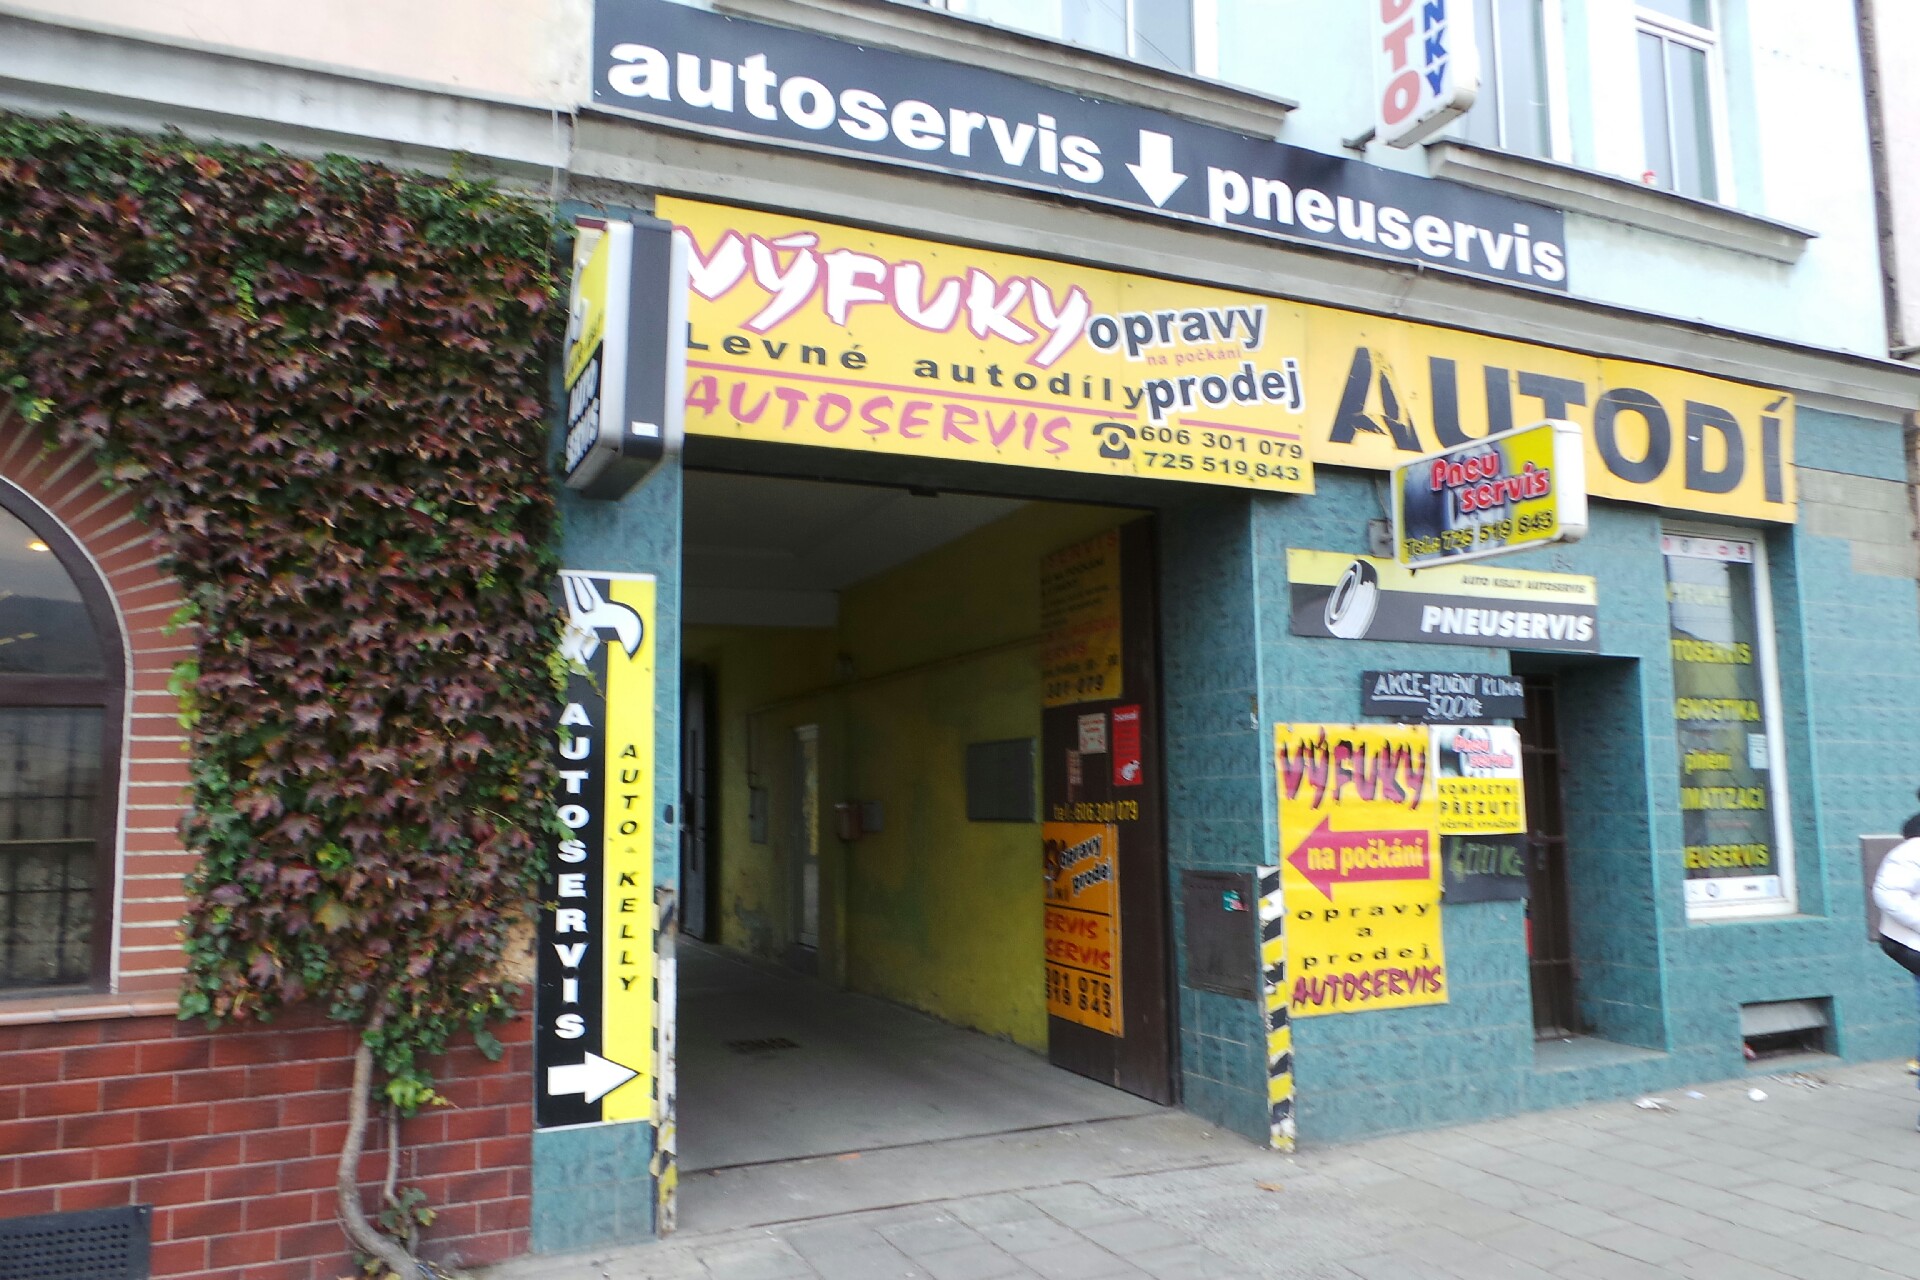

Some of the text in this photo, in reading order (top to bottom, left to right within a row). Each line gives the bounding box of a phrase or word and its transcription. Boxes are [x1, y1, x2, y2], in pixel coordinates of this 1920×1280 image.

[607, 43, 1566, 282] autoservis pneuservis
[1089, 307, 1263, 357] opravy
[687, 321, 1144, 410] Levné autodíly
[1147, 349, 1242, 367] na počkání
[1146, 360, 1302, 420] prodej
[685, 375, 1072, 455] AUTOSERVIS
[1329, 346, 1788, 504] AUTODÍ
[1140, 425, 1303, 459] 606 301 079
[1144, 452, 1300, 481] 725 519 843
[1430, 451, 1500, 492] Pneu
[1460, 461, 1550, 514] servis
[1441, 527, 1475, 551] 725
[1479, 518, 1513, 543] 519
[1518, 510, 1553, 535] 843
[1462, 576, 1489, 586] AUTO
[1420, 605, 1594, 642] PNEUSERVIS
[1481, 676, 1525, 698] KLIMA
[1279, 725, 1427, 811] VÝFUKY
[1116, 799, 1139, 821] 079
[553, 702, 594, 1039] AUTOSERVIS
[618, 743, 640, 992] AUTO KELLY
[1307, 847, 1336, 870] na
[1340, 837, 1424, 877] počkání
[1297, 902, 1431, 923] opravy
[1357, 924, 1373, 938] a
[1302, 943, 1431, 970] prodej
[1078, 977, 1112, 1000] 079
[1078, 994, 1112, 1019] 843
[1292, 965, 1442, 1009] AUTOSERVIS
